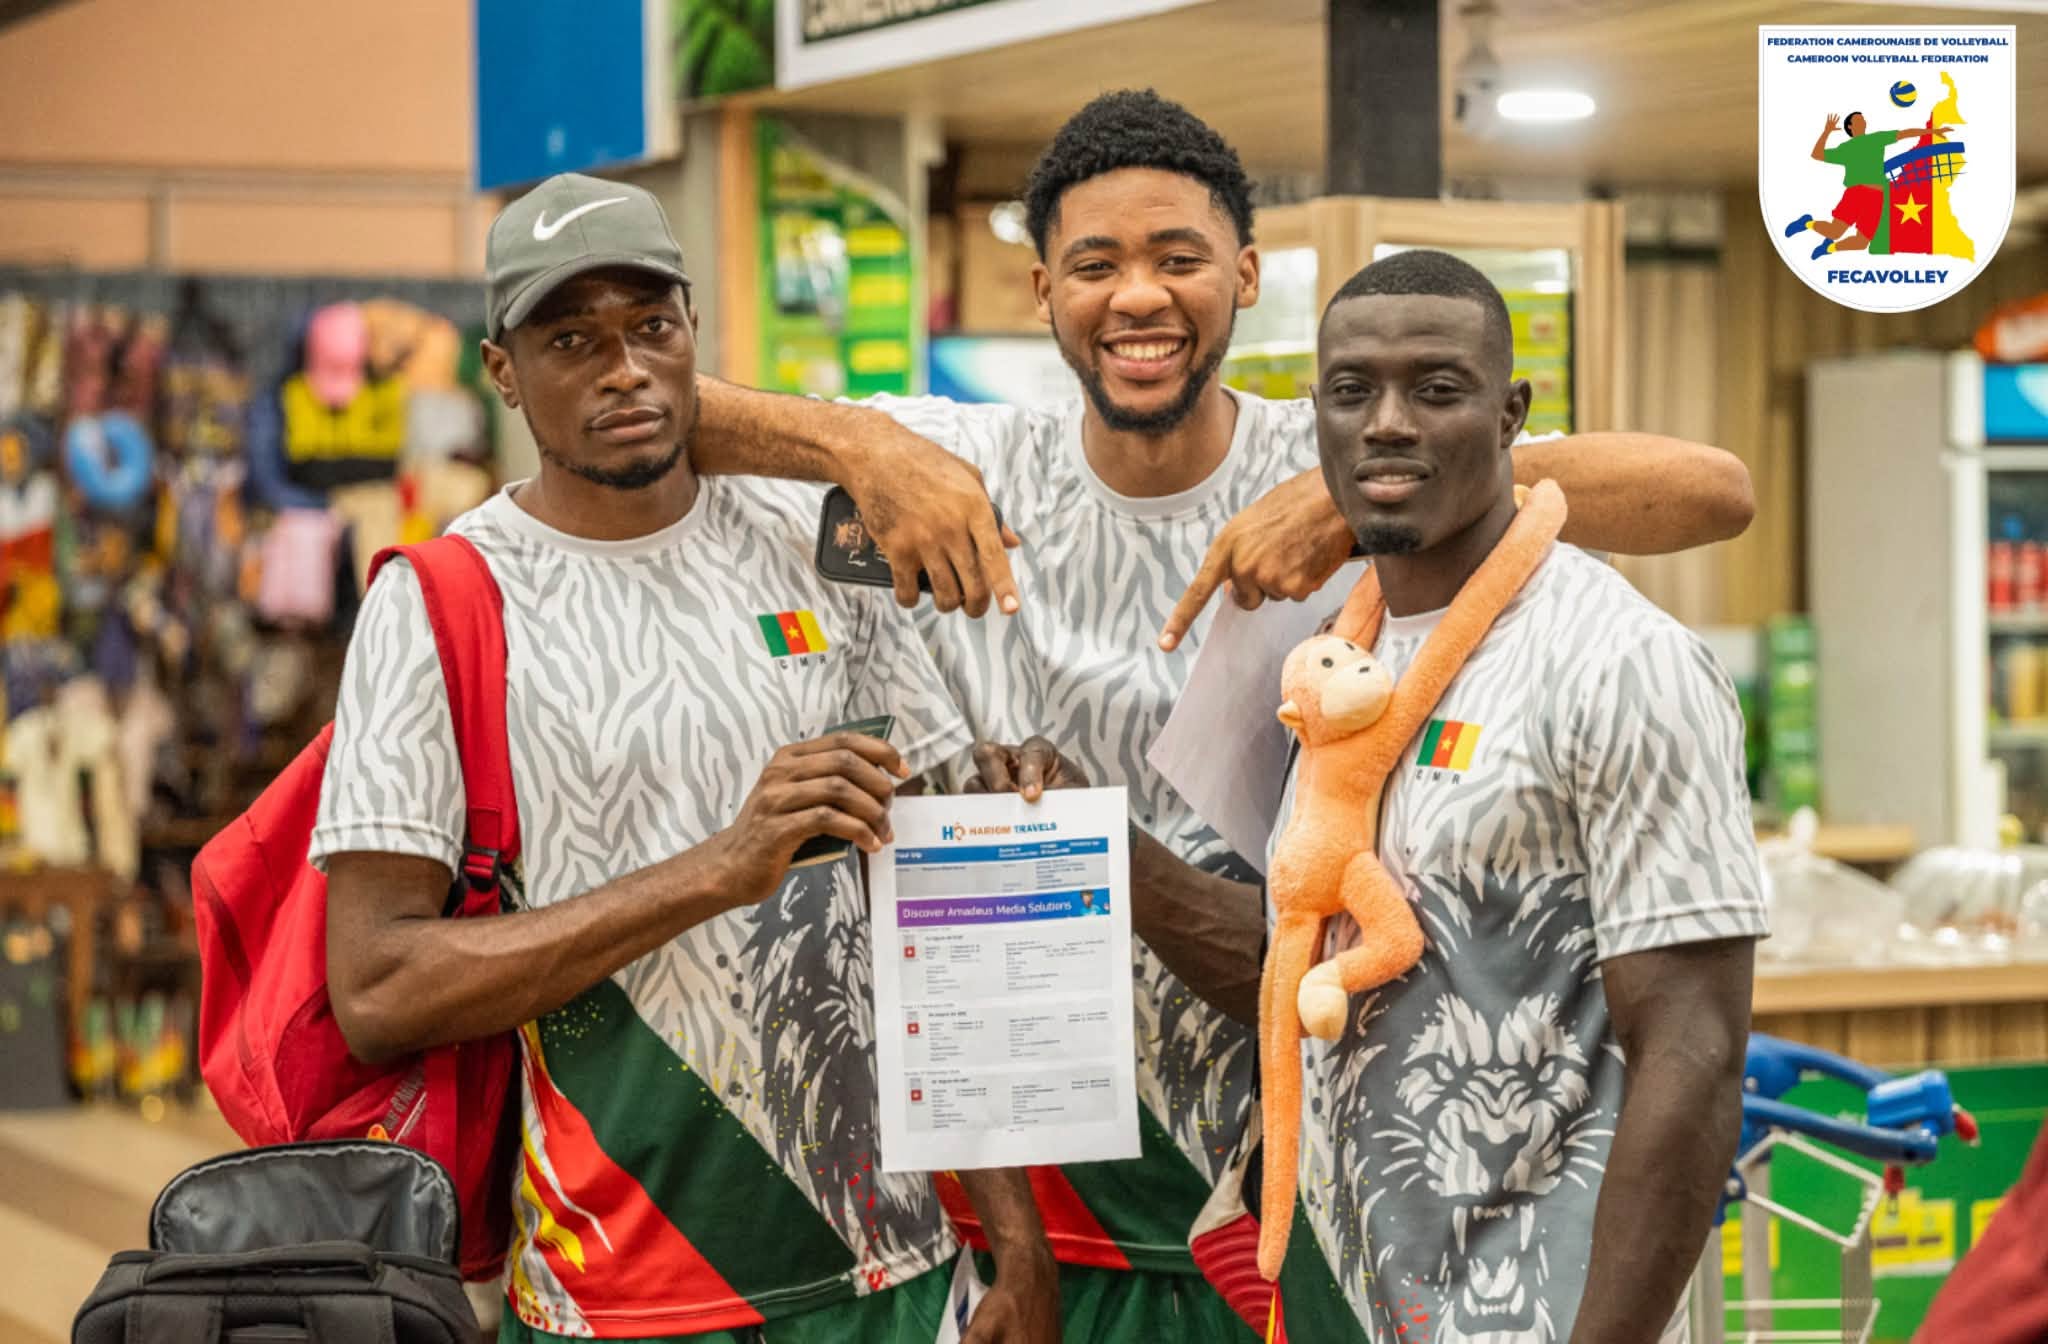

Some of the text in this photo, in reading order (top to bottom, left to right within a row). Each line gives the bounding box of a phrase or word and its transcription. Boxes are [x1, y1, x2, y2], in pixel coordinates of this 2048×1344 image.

[1014, 822, 1057, 833] TRAVELS
[903, 901, 1072, 919] Discover Amadeus Media Solutions
